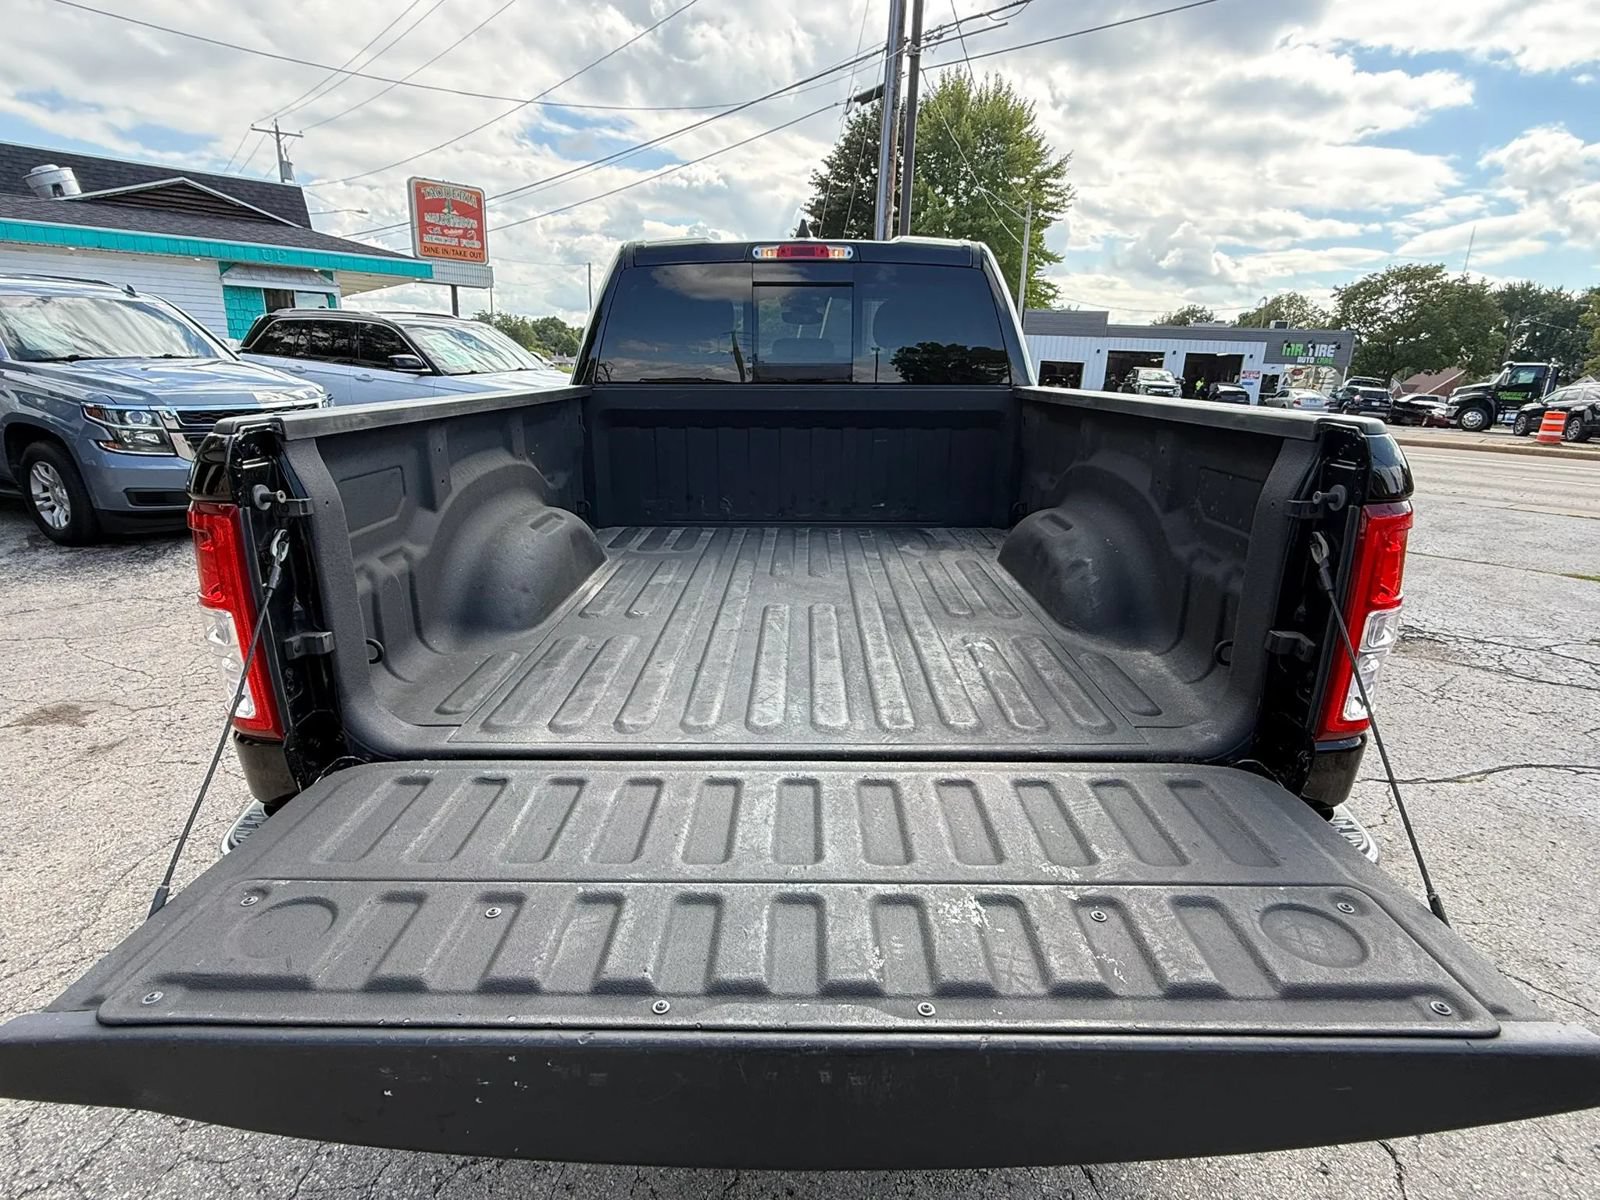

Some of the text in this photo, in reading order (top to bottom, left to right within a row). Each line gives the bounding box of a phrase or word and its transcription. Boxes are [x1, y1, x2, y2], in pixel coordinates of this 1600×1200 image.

[424, 246, 439, 255] DINE
[469, 251, 482, 259] OUT
[1308, 343, 1336, 358] TIRE
[1297, 356, 1315, 364] AUTO
